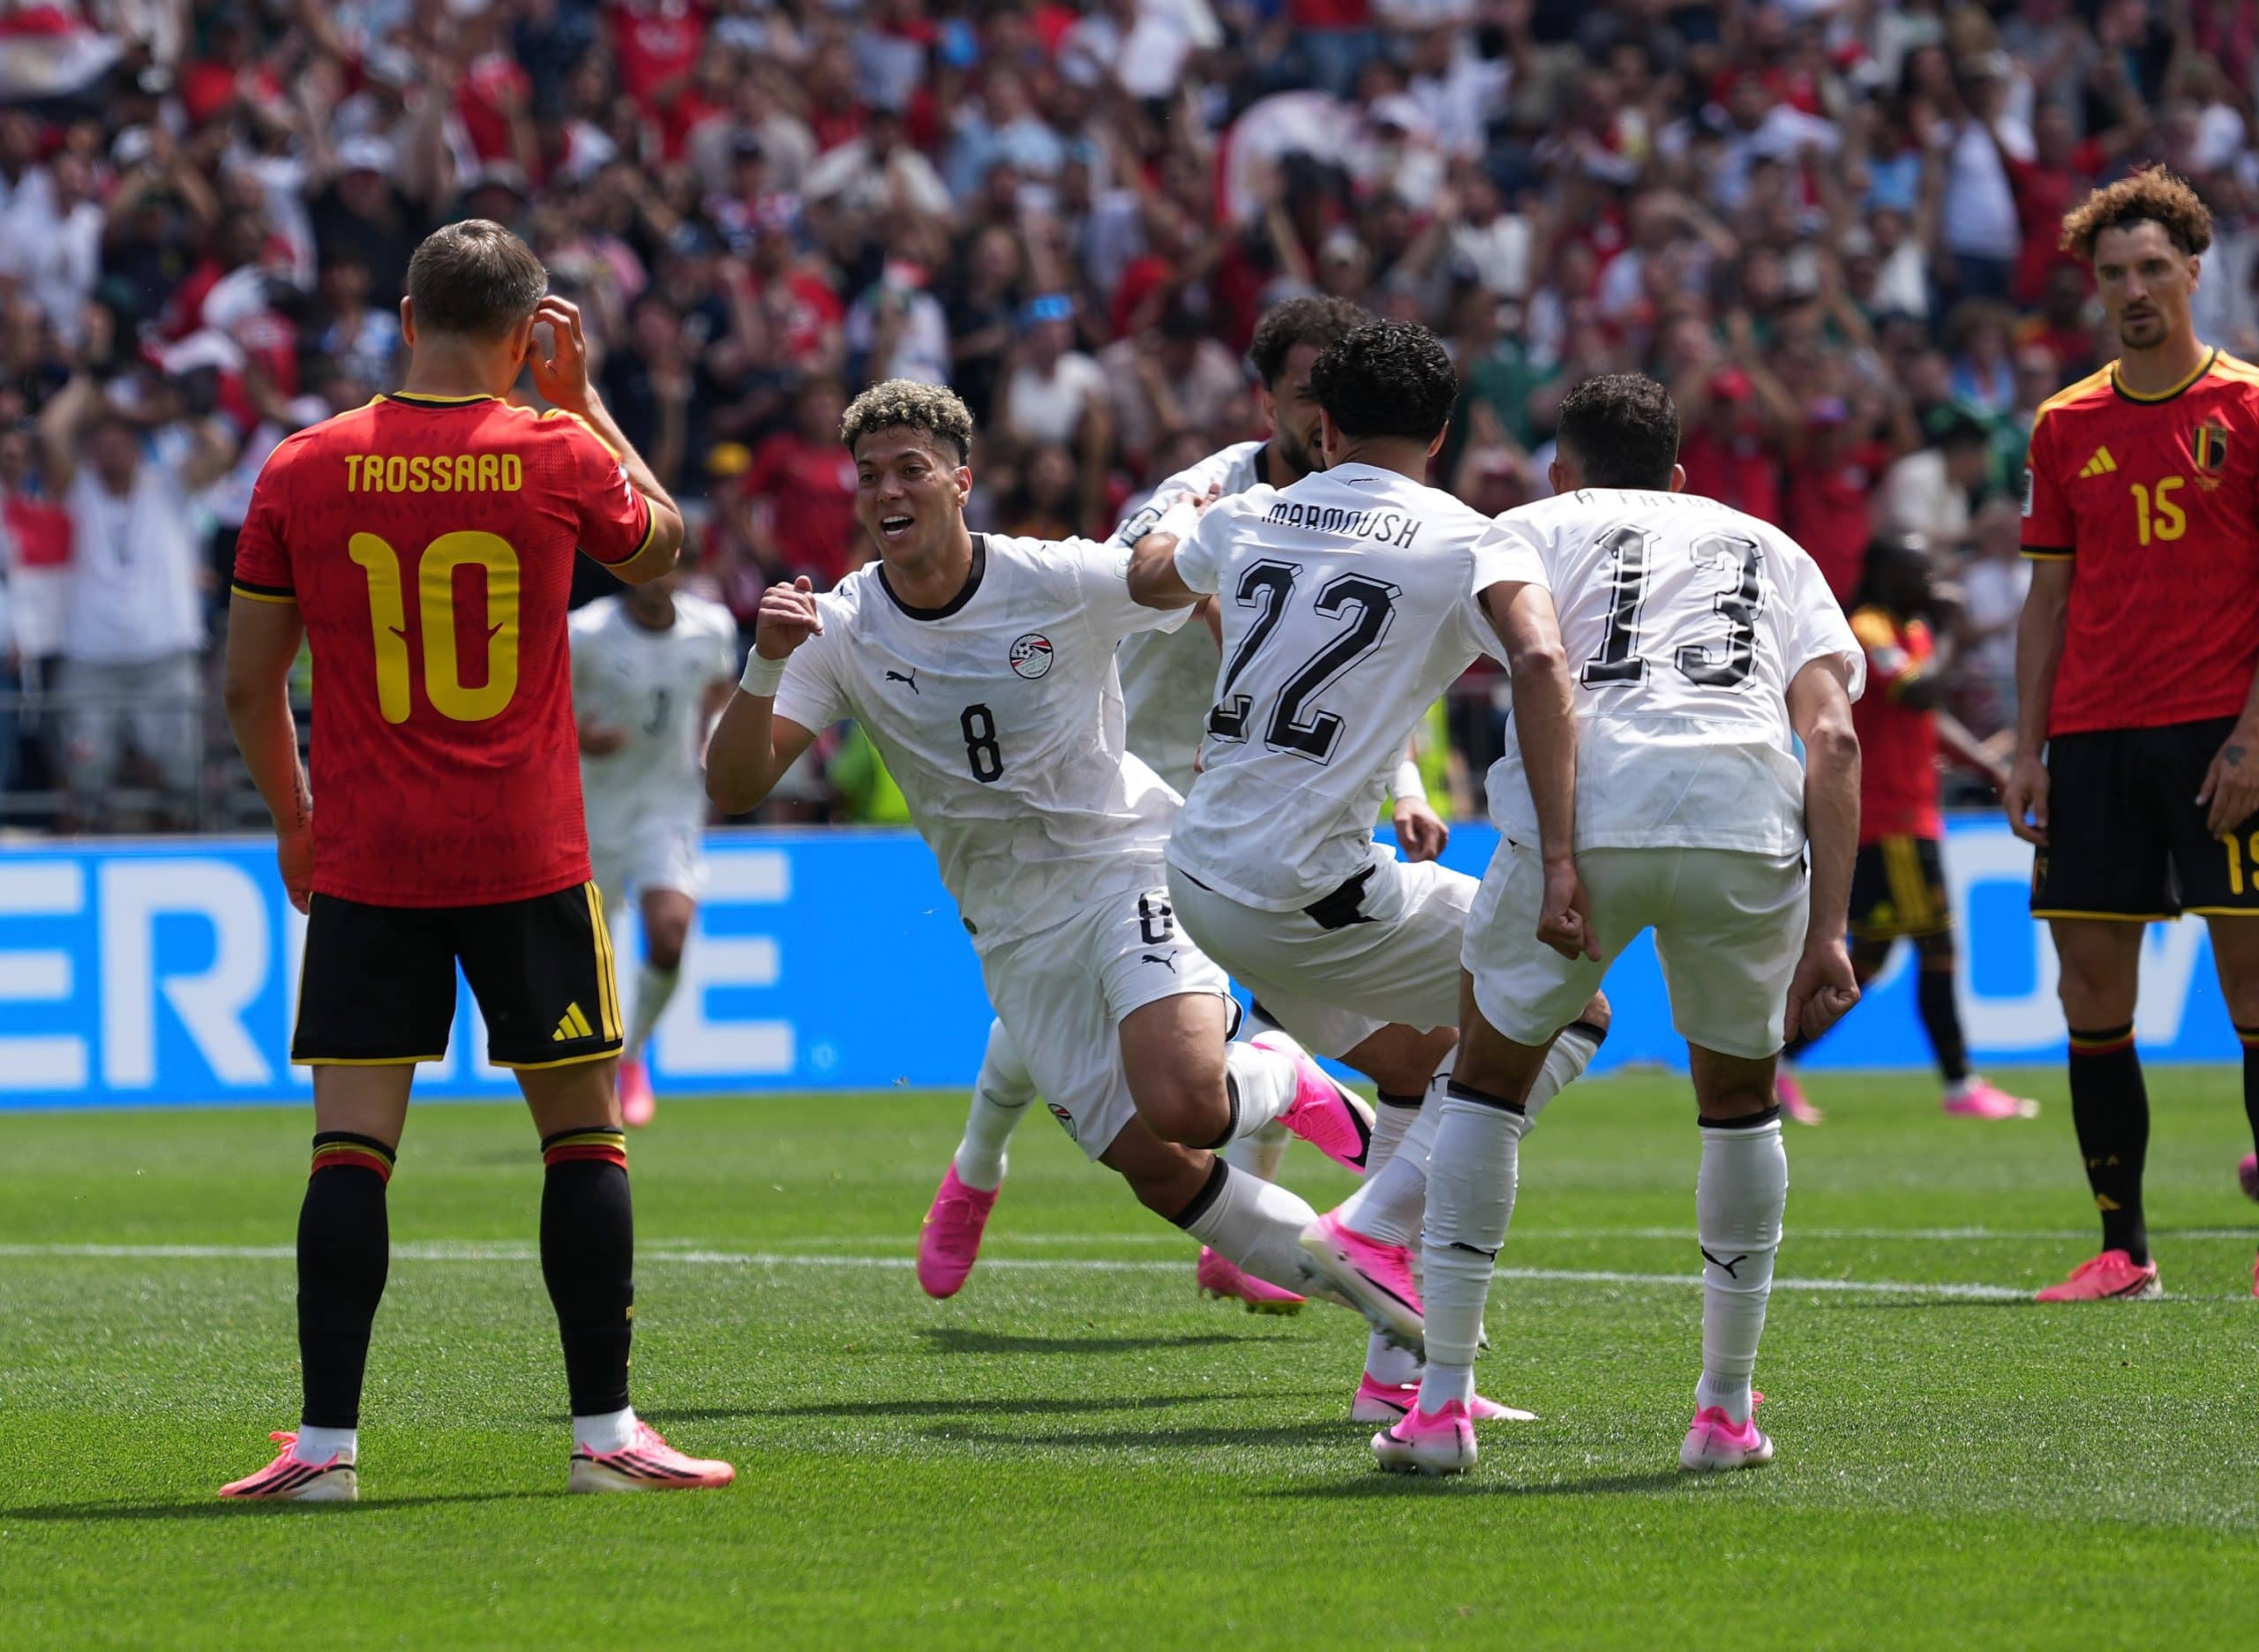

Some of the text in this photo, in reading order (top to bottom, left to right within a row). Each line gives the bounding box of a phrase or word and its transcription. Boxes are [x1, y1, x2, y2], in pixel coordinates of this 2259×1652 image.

[345, 454, 522, 492] TROSSARD
[2131, 475, 2186, 545] 15
[1262, 502, 1422, 549] MARMOUSH
[349, 531, 520, 724] 10
[1580, 523, 1764, 695] 13
[1206, 557, 1402, 766] 22
[960, 703, 1004, 784] 8
